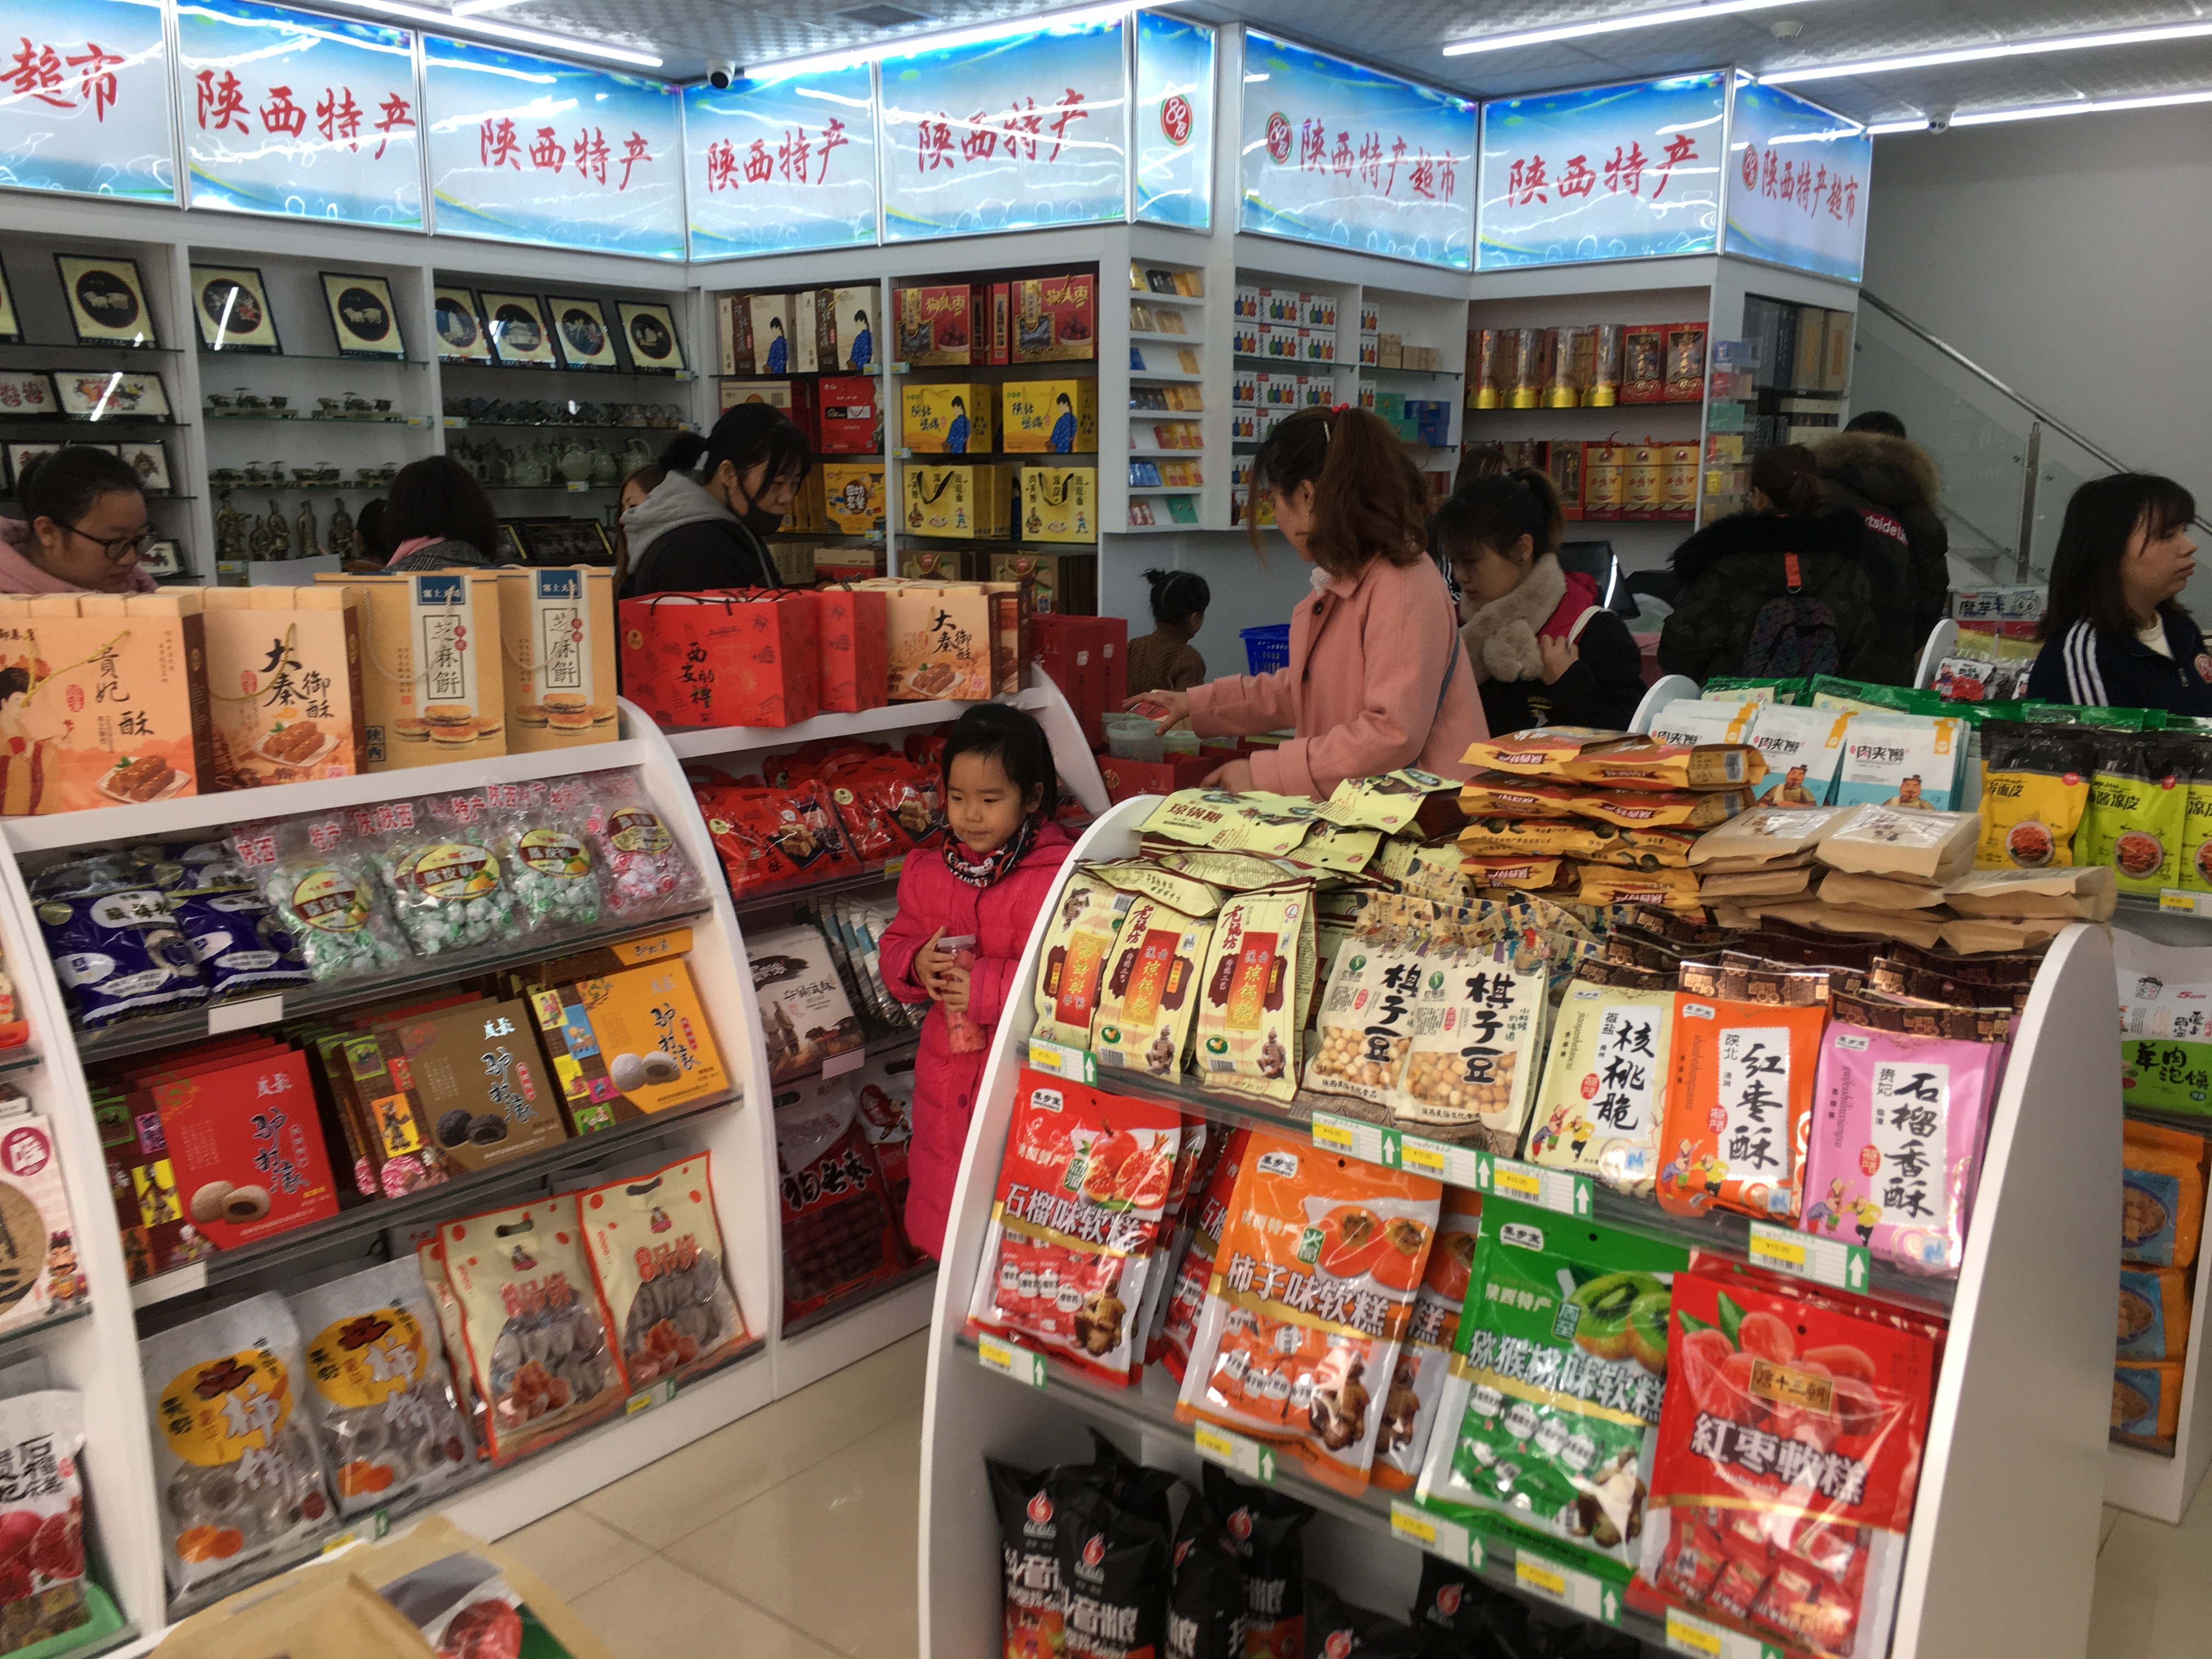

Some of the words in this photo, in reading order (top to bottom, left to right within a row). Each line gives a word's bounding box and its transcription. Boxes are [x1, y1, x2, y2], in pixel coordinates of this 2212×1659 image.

[0, 37, 125, 123] 超市
[195, 69, 416, 160] 陕西特产
[479, 117, 652, 191] 陕西特产
[707, 117, 848, 194] 陕西特产
[1508, 133, 1699, 208] 陕西特产
[1762, 148, 1859, 228] 陕西特产超市
[1856, 744, 1906, 762] 肉夹馍
[1363, 963, 1423, 1064] 棋子豆
[1460, 972, 1517, 1085] 棋子豆
[1593, 1020, 1655, 1131] 核桃脆
[1727, 1043, 1786, 1170] 红枣酥
[1884, 1072, 1939, 1220] 石榴香酥
[1227, 1251, 1389, 1338] 柿子味软糕
